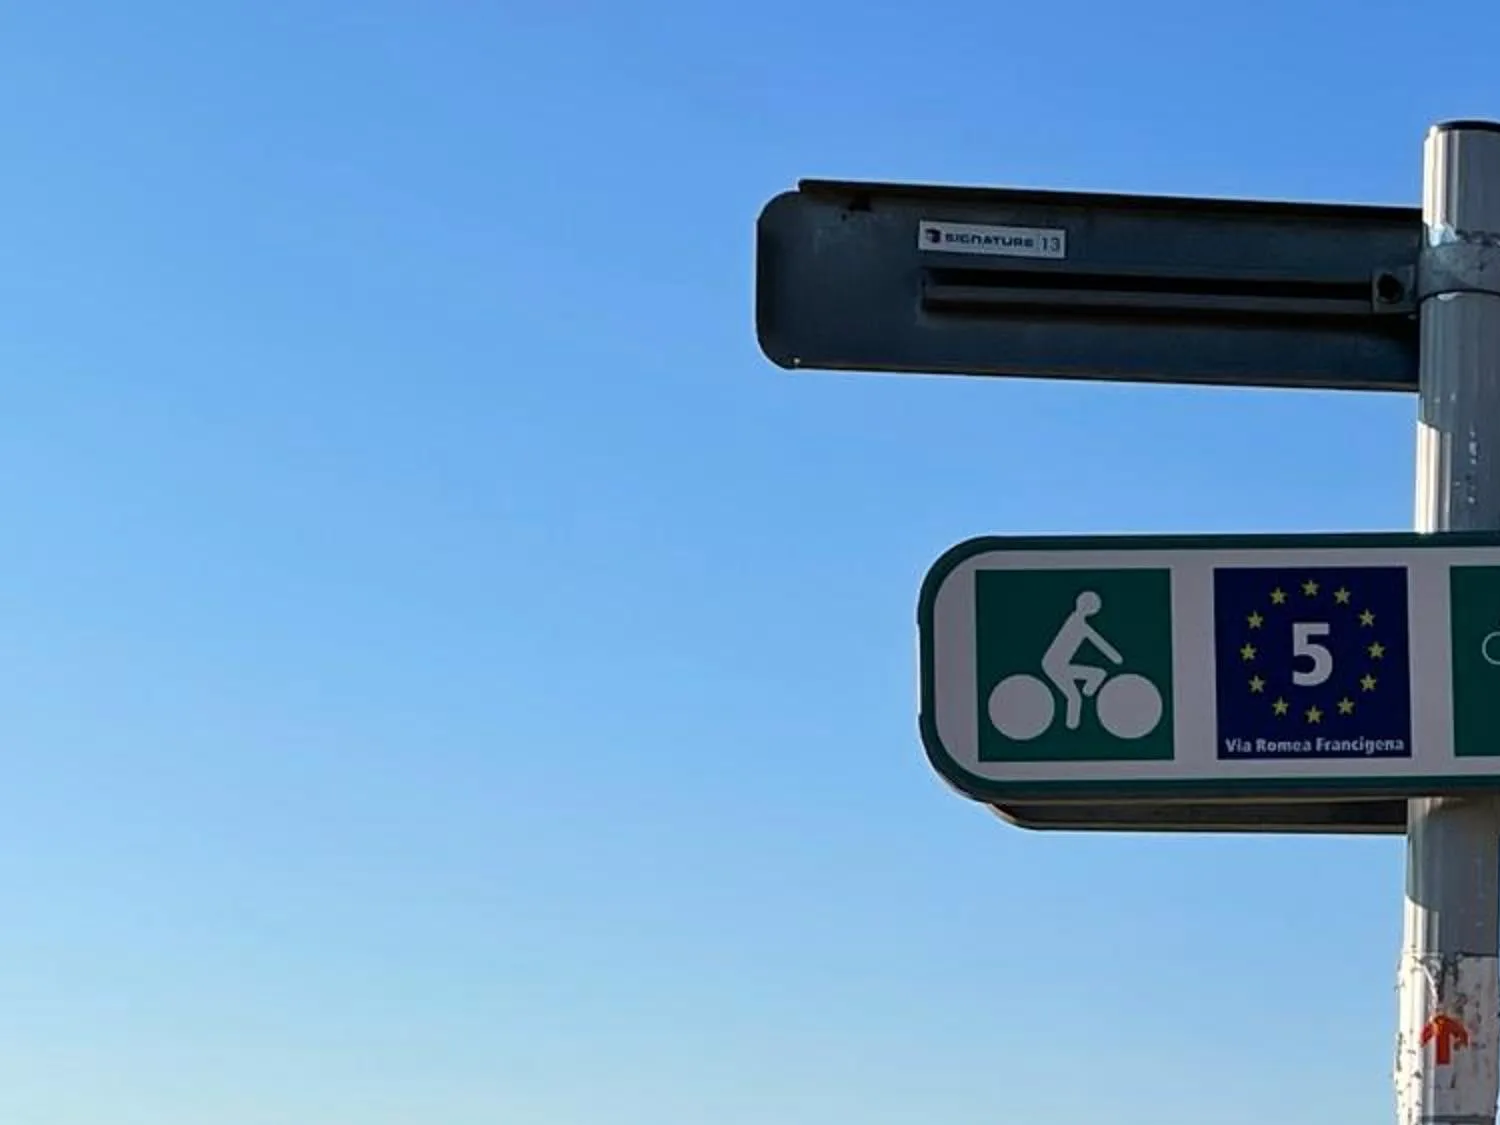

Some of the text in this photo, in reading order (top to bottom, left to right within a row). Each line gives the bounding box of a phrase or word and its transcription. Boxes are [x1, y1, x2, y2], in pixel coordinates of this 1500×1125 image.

[945, 233, 1034, 248] SIGNATURE
[1292, 622, 1333, 687] 5
[1225, 736, 1404, 755] Via Romea Francigena
